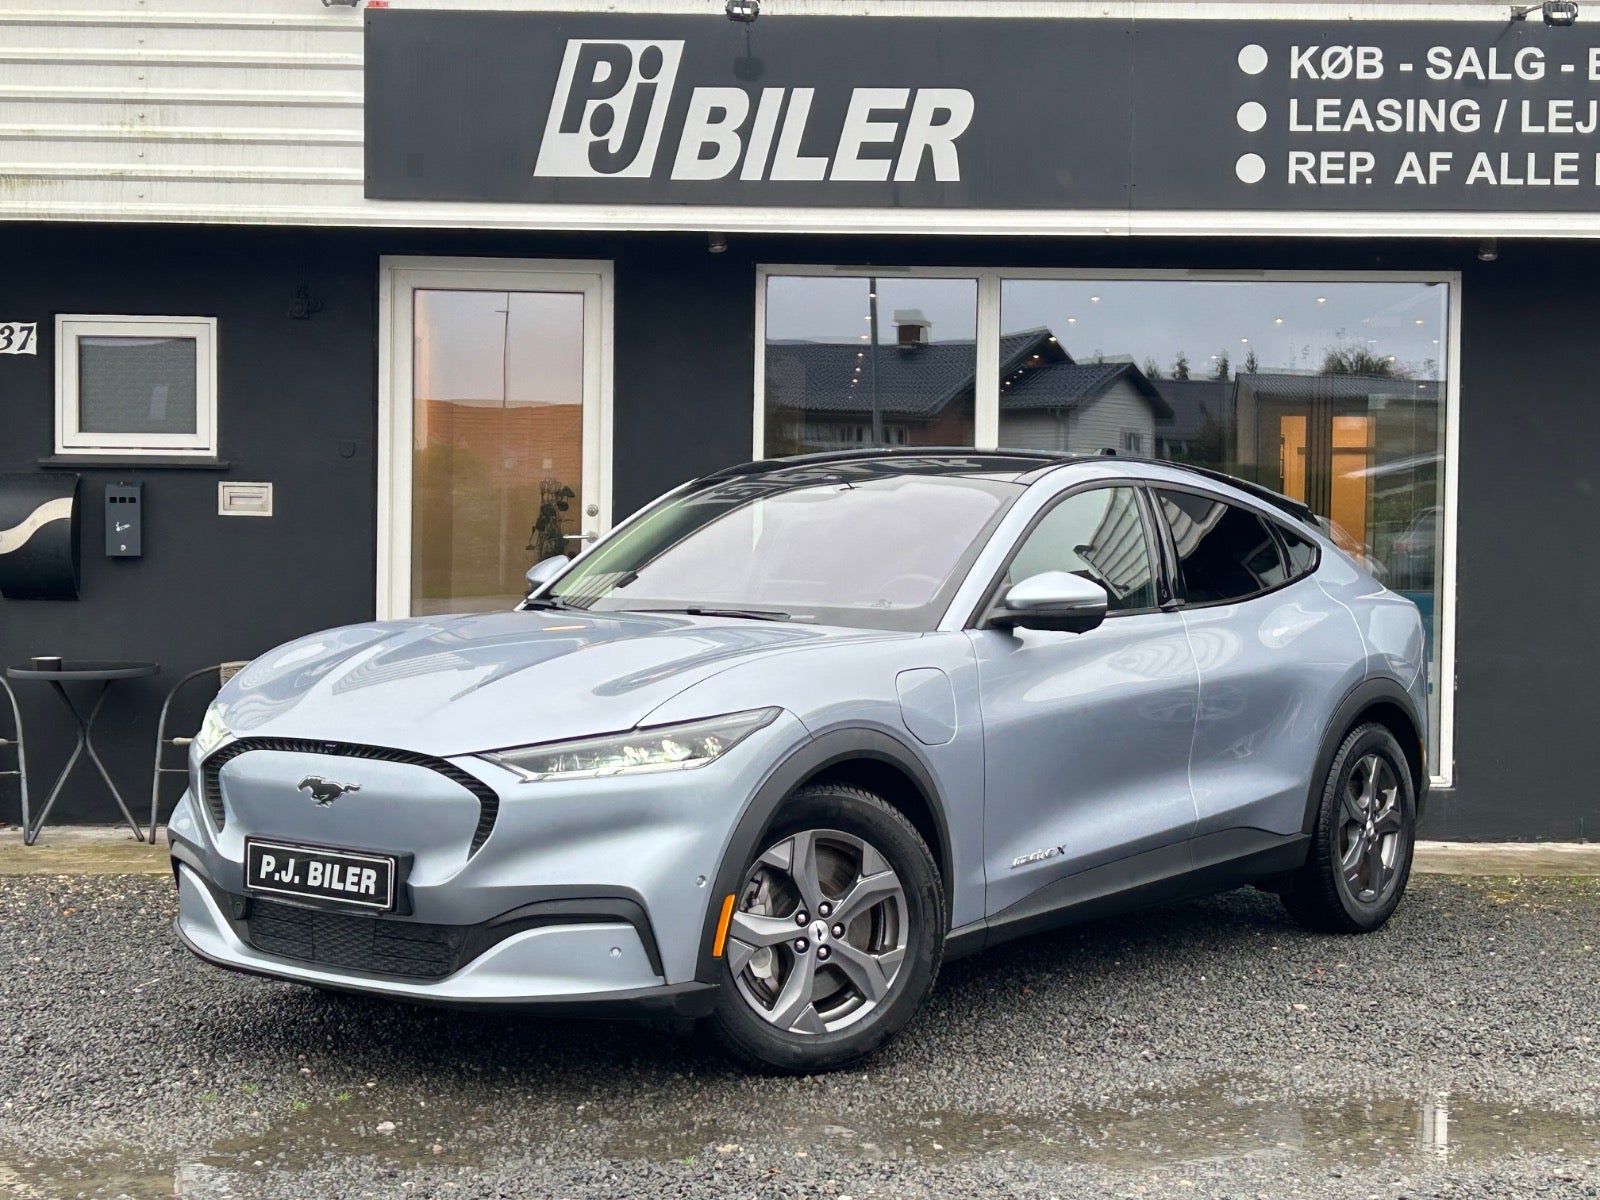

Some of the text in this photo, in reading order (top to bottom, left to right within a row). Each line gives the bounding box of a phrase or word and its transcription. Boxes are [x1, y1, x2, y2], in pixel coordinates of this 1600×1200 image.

[1290, 45, 1384, 80] KØB
[1425, 46, 1546, 80] SALG
[1289, 98, 1481, 133] LEASING
[670, 87, 975, 182] BILER
[1288, 151, 1376, 184] REP.
[1395, 151, 1453, 184] AF
[1465, 152, 1580, 185] ALLE
[0, 324, 35, 351] 37
[259, 854, 377, 895] P.J. BILER
